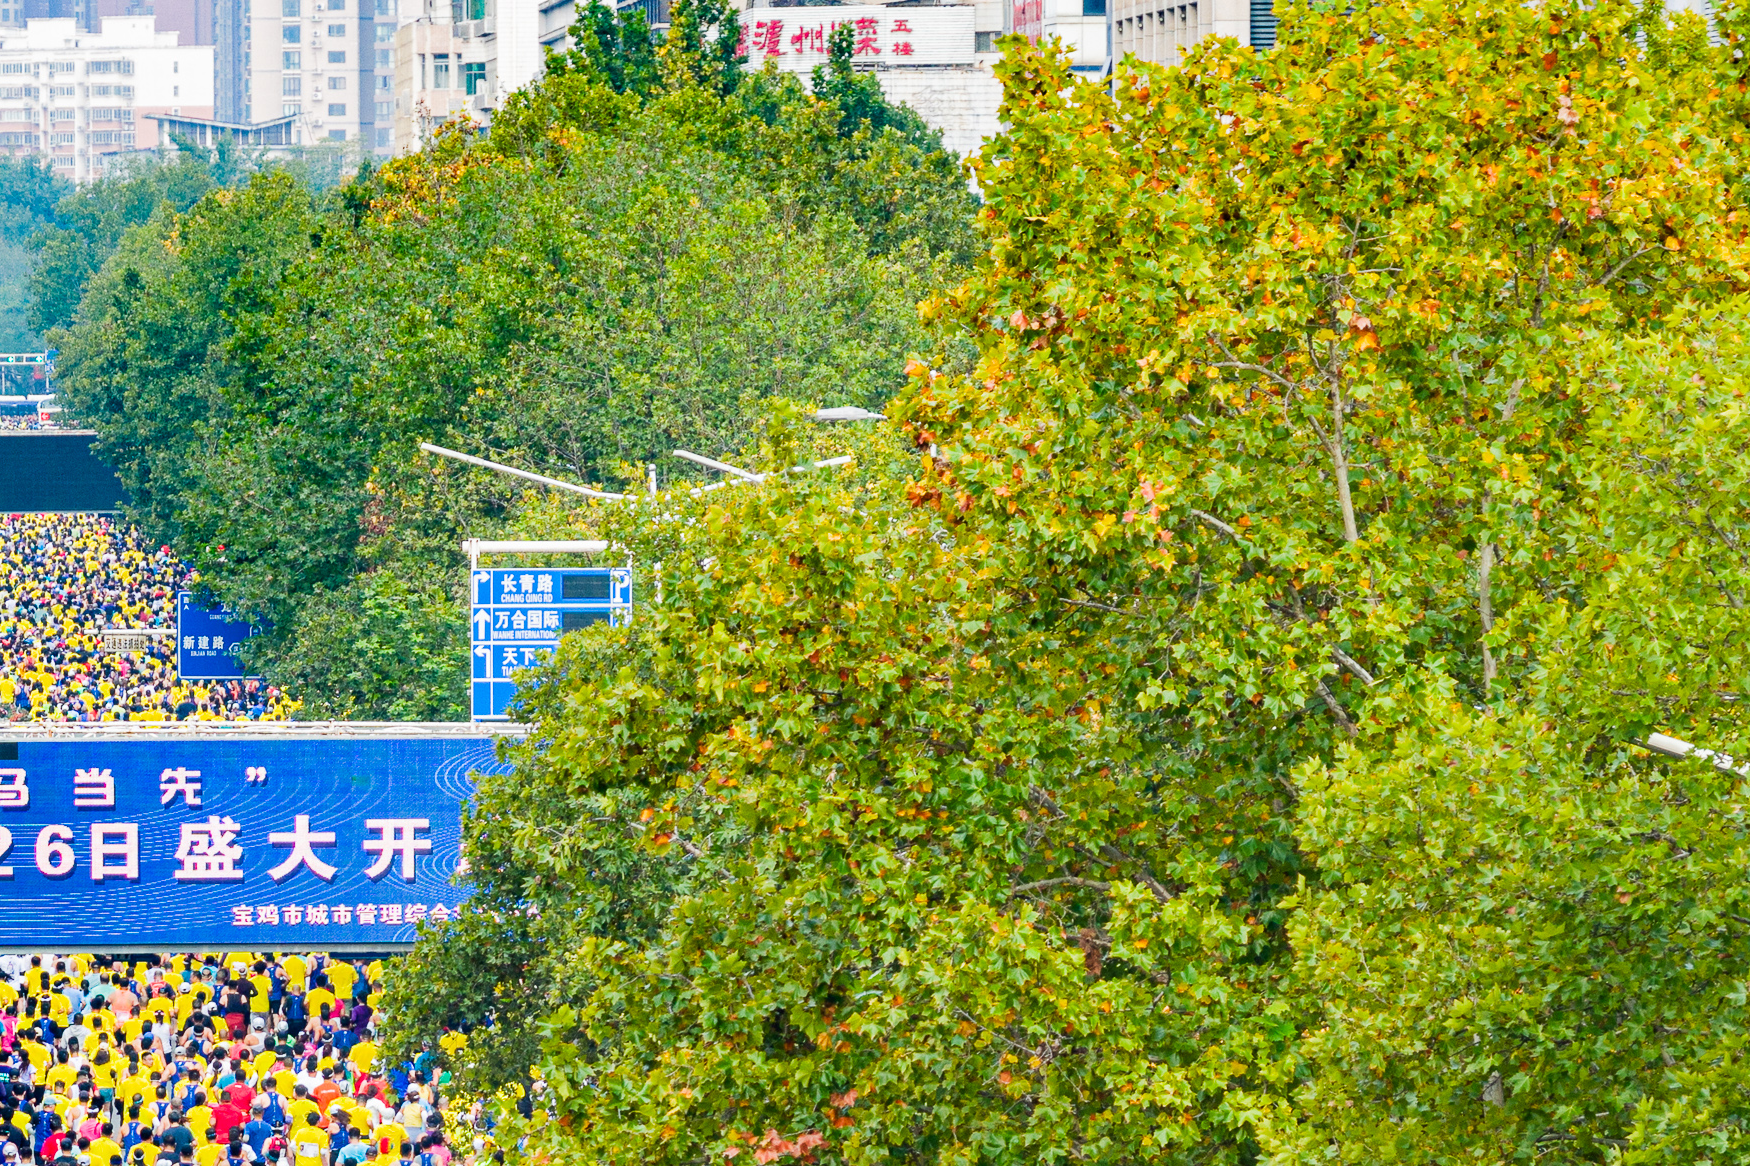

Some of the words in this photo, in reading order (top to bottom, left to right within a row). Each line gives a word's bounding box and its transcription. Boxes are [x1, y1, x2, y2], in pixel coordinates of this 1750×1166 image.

[501, 574, 554, 593] 长青路
[501, 594, 525, 603] CHANG
[525, 594, 543, 603] QING
[543, 594, 553, 603] RD
[494, 610, 560, 629] 万合国际
[183, 635, 224, 650] 新建路
[493, 631, 514, 639] WANHE
[232, 903, 461, 926] 宝鸡市城市管理综合
